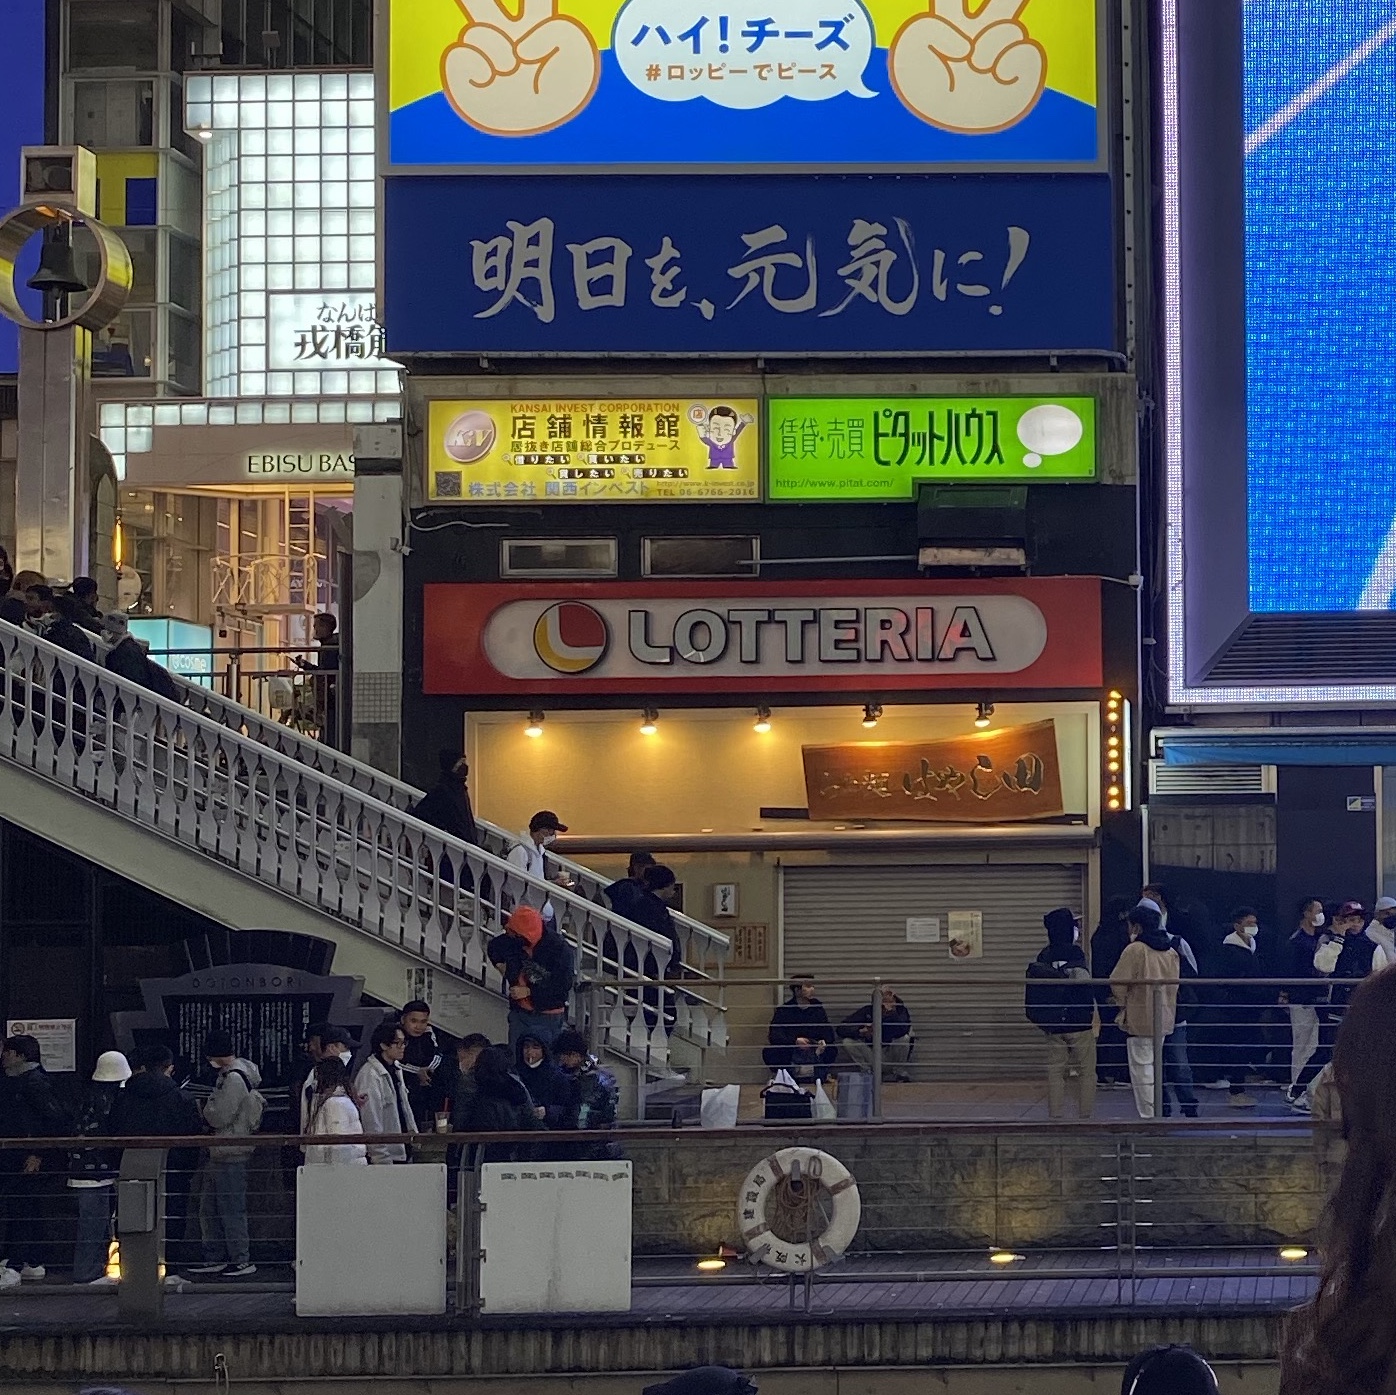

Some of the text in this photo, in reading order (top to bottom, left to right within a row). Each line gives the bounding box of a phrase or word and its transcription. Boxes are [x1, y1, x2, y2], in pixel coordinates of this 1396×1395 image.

[631, 13, 855, 54] ハイ!チーズ
[645, 61, 837, 81] #ロッピーでピース
[469, 217, 1030, 323] 明日を、元気に!
[510, 403, 680, 413] KANSAI INVEST CORPORATION
[511, 413, 680, 439] 店舗情報館
[873, 407, 1005, 467] ピタットハウス
[779, 417, 865, 460] 賃貸・売買
[248, 454, 313, 473] EBISU
[468, 482, 649, 497] 株式会社 関西インベスト
[656, 488, 675, 496] TEL
[775, 478, 894, 489] http://www.pitat.com/
[628, 605, 997, 665] LOTTERIA
